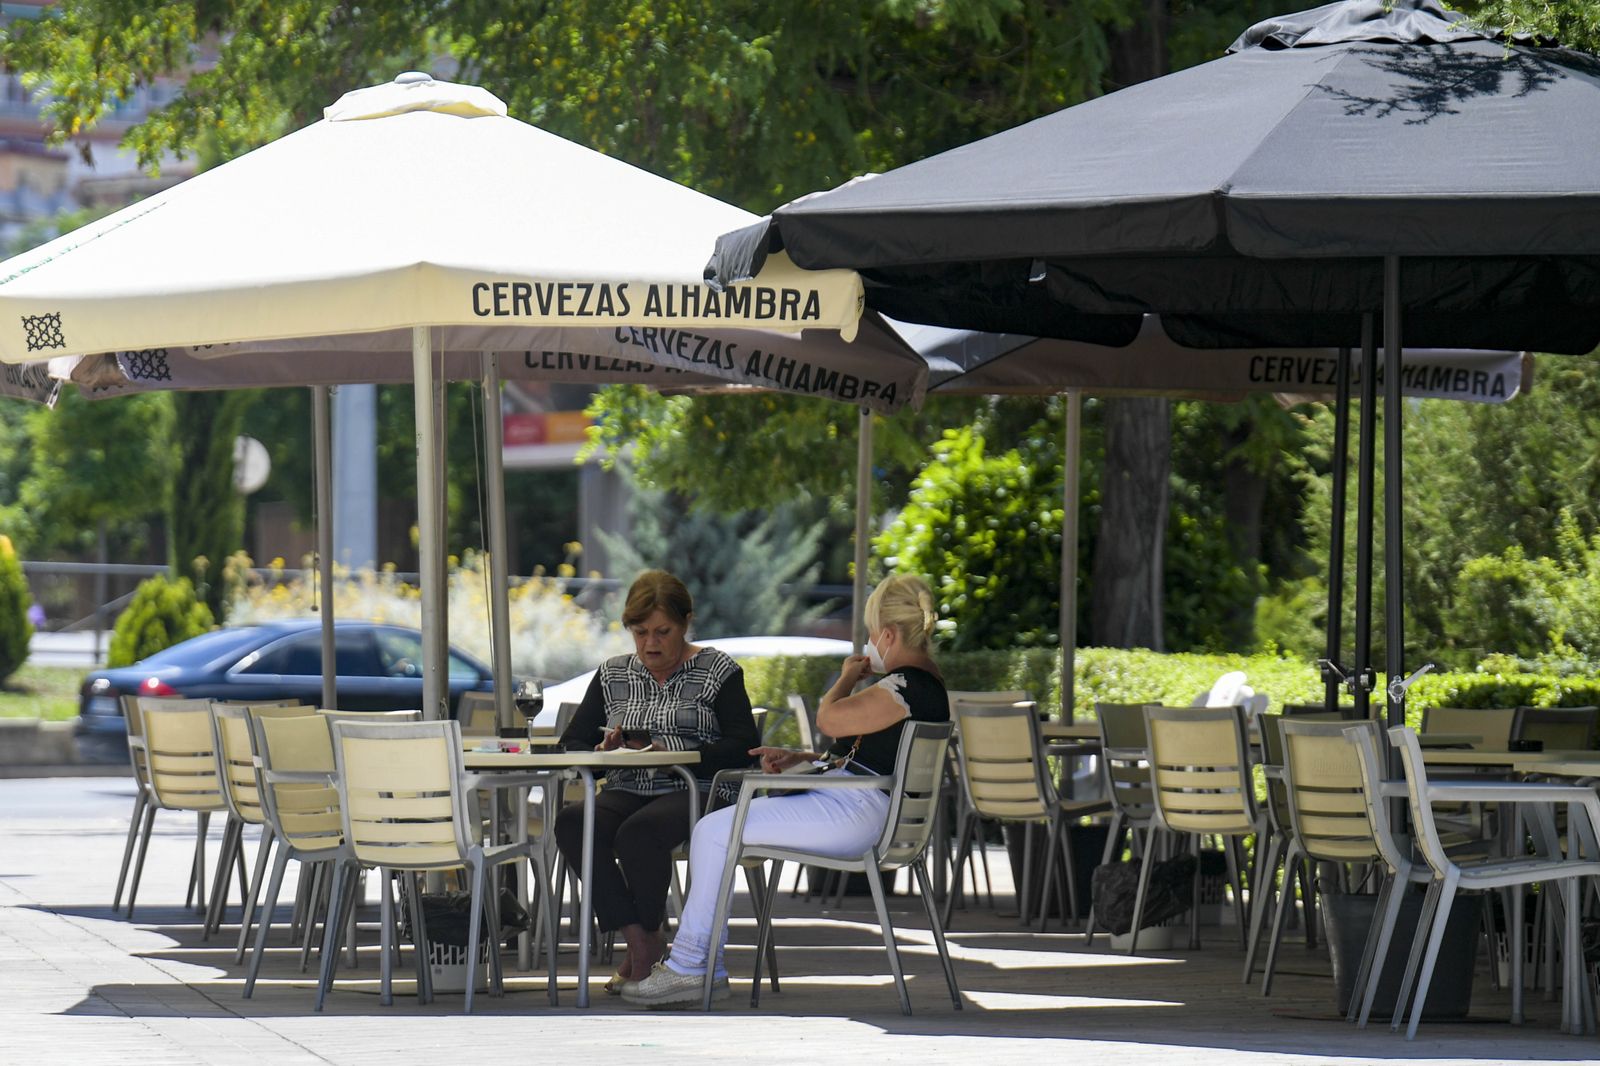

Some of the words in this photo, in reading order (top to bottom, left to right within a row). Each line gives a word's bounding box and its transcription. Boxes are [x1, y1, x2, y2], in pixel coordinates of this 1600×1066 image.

[473, 282, 630, 317] CERVEZAS
[644, 284, 821, 321] ALHAMBRA
[615, 327, 737, 370] CERVEZAS
[745, 350, 898, 405] ALHAMBRA
[1249, 356, 1364, 386] CERVEZS
[1373, 362, 1506, 398] AHAMBRA
